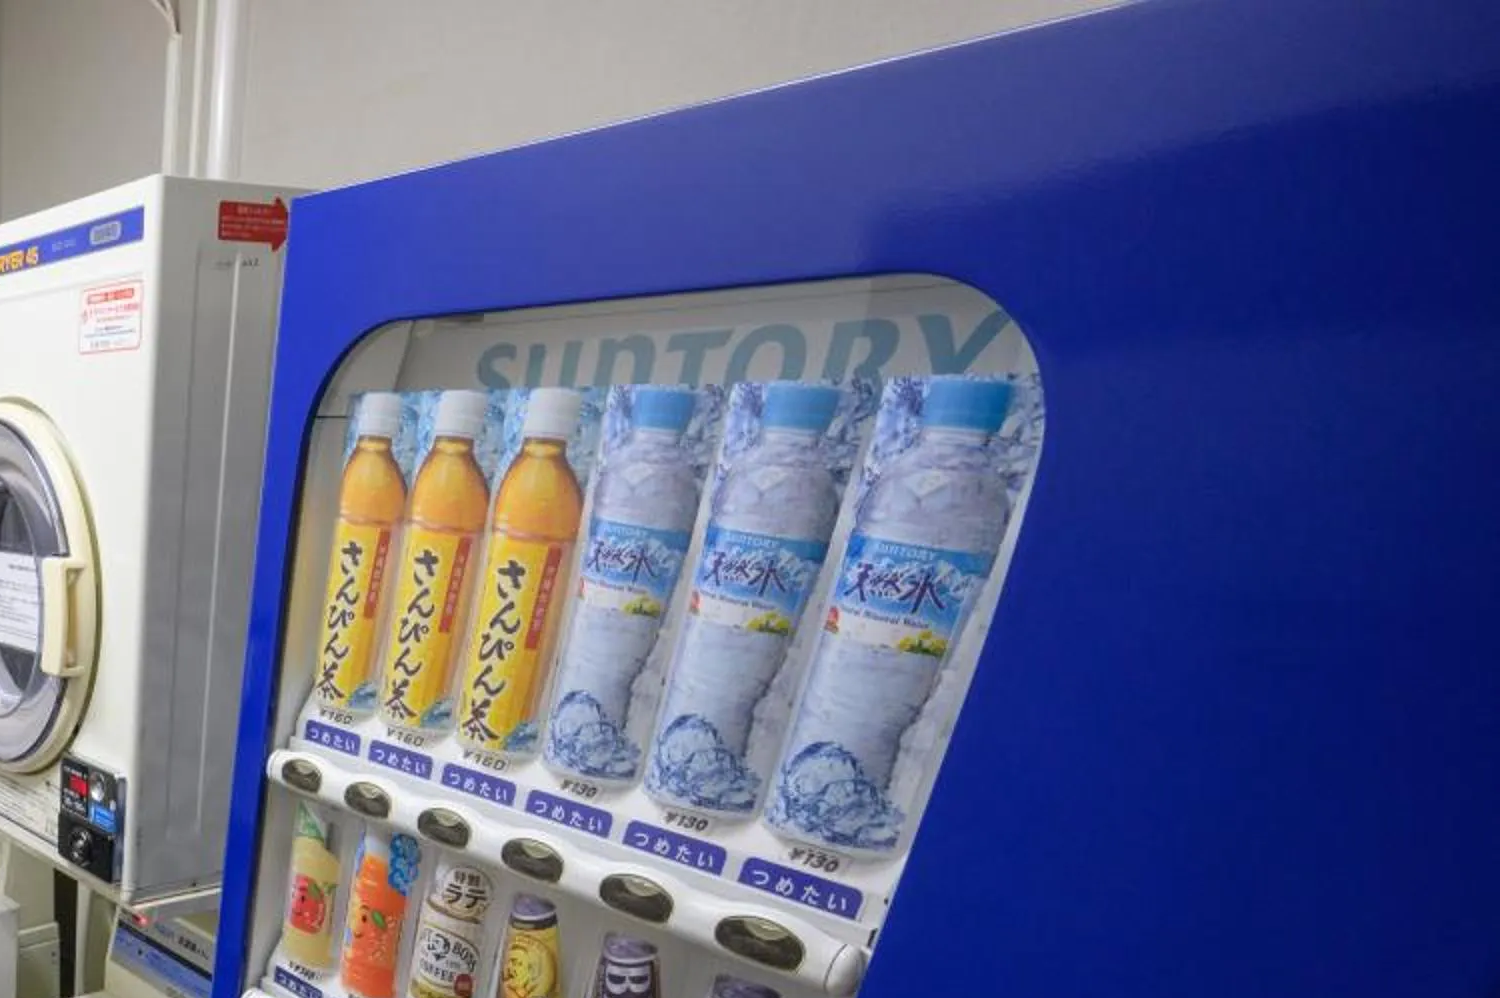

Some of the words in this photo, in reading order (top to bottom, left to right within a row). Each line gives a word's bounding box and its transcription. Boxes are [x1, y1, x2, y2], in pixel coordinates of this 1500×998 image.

[316, 541, 364, 700] さんぴん茶
[385, 549, 440, 720] さんぴん茶
[462, 559, 525, 742] さんぴん茶
[307, 726, 357, 751] つめたい
[374, 749, 428, 775] つめたい
[449, 771, 509, 802] つめたい
[534, 800, 604, 833] つめたい
[664, 810, 709, 832] ¥130
[633, 832, 715, 870] つめたい
[790, 847, 840, 873] ¥130
[751, 869, 848, 913] つめたい
